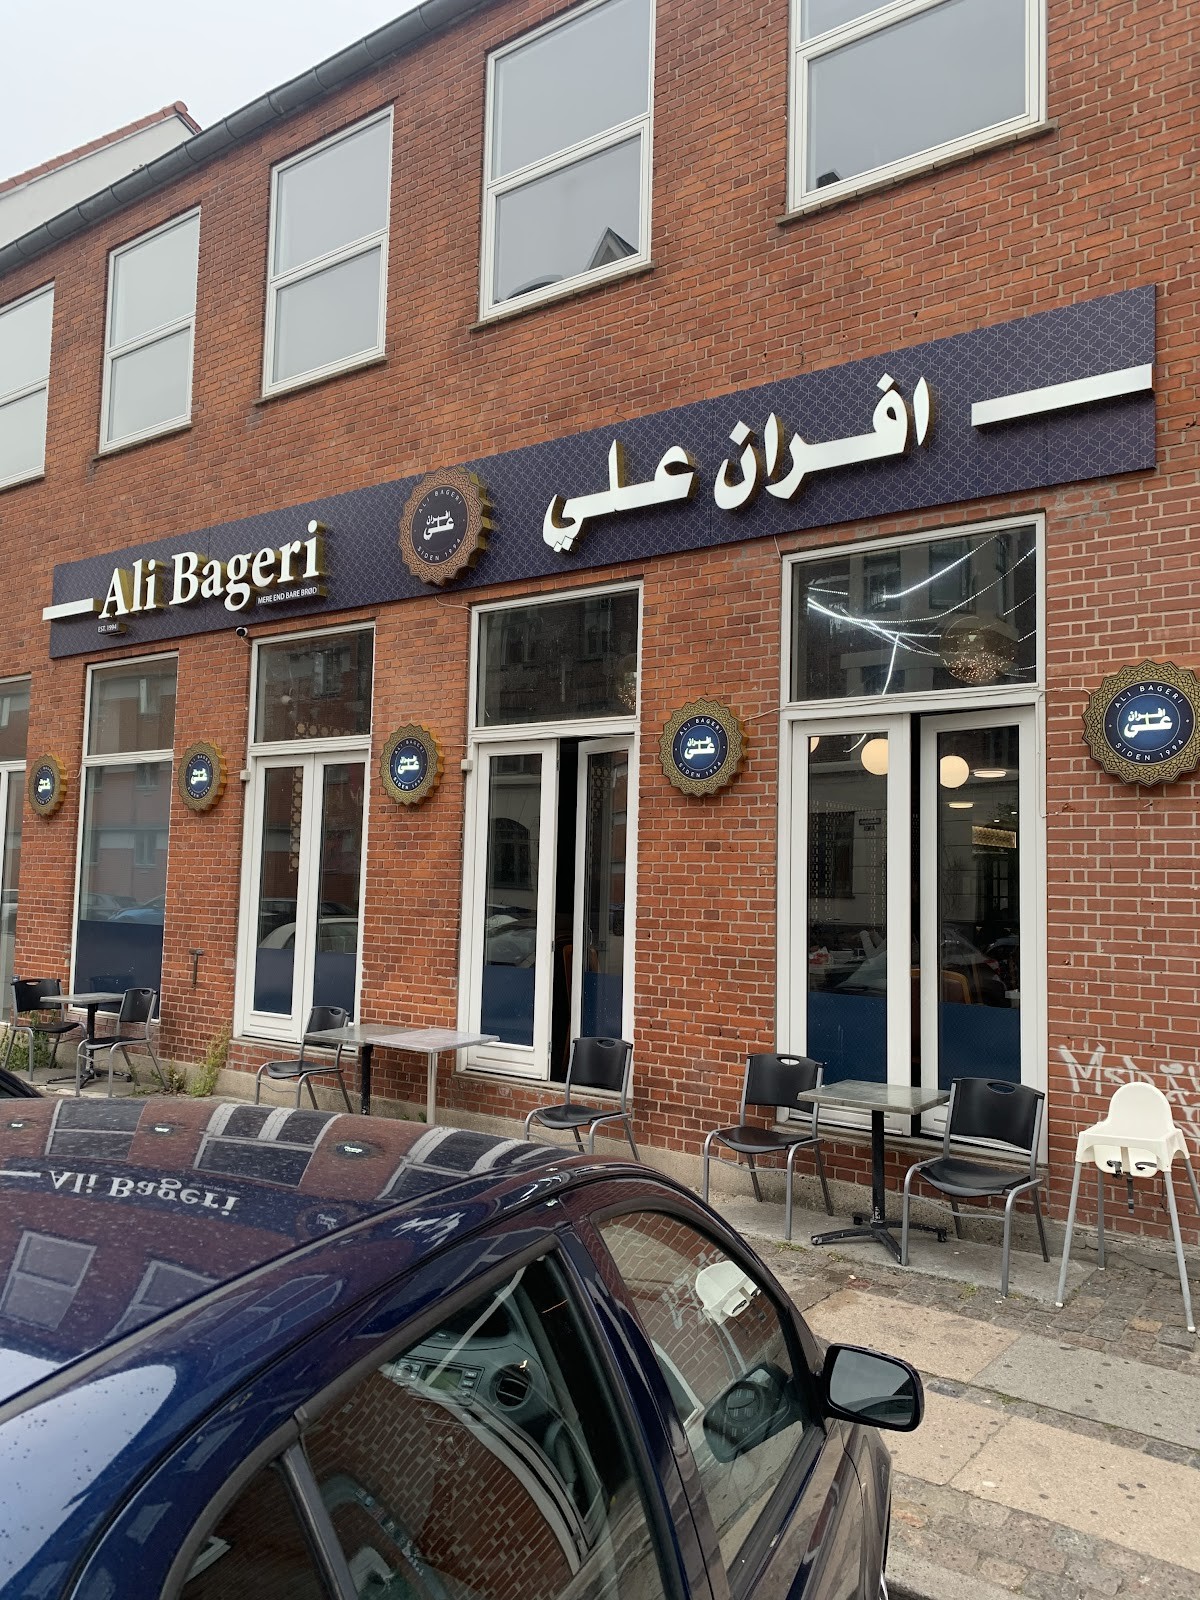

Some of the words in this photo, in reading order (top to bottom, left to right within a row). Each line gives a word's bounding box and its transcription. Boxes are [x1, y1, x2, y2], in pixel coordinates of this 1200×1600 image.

[714, 372, 930, 510] افران
[418, 497, 430, 514] ALI
[434, 490, 462, 504] BAGERI
[542, 438, 694, 552] علي
[417, 546, 439, 560] SIDEN
[444, 538, 460, 557] 1994
[98, 558, 157, 619] Ali
[169, 520, 320, 612] Bageri
[258, 595, 272, 604] MERE
[273, 593, 285, 601] END
[285, 590, 300, 599] BARE
[300, 586, 317, 596] BRØD
[1115, 692, 1131, 708] ALI
[1140, 685, 1183, 704] BAGERI
[680, 723, 691, 736] ALI
[696, 718, 722, 734] BAGERI
[1116, 742, 1150, 760] SIDEN
[1159, 739, 1183, 758] 1994
[678, 762, 700, 777] SIDEN
